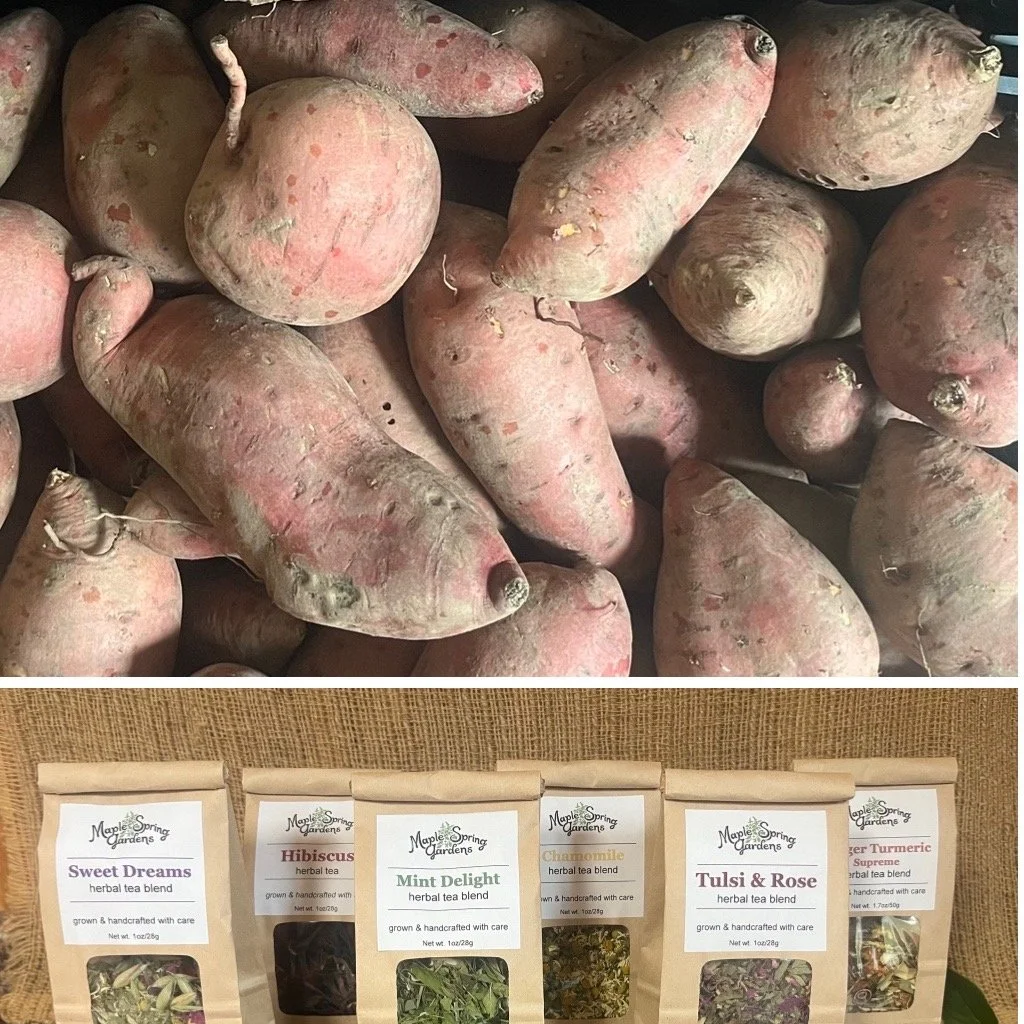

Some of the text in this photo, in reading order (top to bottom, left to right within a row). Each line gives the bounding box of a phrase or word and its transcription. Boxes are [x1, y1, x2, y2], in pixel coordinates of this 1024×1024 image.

[877, 800, 911, 823] Spring
[285, 810, 354, 832] Maple Spring
[548, 806, 618, 831] Maple Spring
[855, 816, 898, 831] Gardens
[89, 815, 170, 842] Maple Spring
[300, 823, 341, 836] Gardens
[563, 822, 605, 836] Gardens
[718, 821, 796, 849] Maple Spring
[107, 833, 154, 849] Gardens
[408, 826, 487, 853] Maple Spring
[425, 843, 473, 860] Gardens
[734, 839, 782, 855] Gardens
[849, 842, 931, 856] ger Turmeric
[281, 849, 354, 862] Hibiscus
[542, 849, 625, 862] Chamomile
[853, 859, 900, 868] Supreme
[68, 864, 192, 878] Sweet Dreams
[295, 867, 339, 875] herbal tea
[548, 866, 618, 875] herbal tea blend
[849, 870, 869, 878] erbal
[887, 869, 911, 878] blend
[396, 872, 500, 889] Mint Delight
[695, 872, 817, 888] Tulsi & Rose
[89, 883, 173, 893] herbal tea blend
[853, 887, 894, 896] handcrafted
[265, 892, 286, 900] grown
[295, 891, 336, 899] handcrafted
[338, 891, 352, 899] with
[409, 890, 489, 902] herbal tea blend
[717, 894, 796, 904] herbal tea blend
[73, 917, 97, 926] grown
[107, 916, 156, 925] handcrafted
[158, 916, 175, 924] with
[696, 924, 721, 932] grown
[731, 923, 777, 931] handcrafted
[779, 923, 795, 931] with
[389, 924, 413, 933] grown
[424, 923, 471, 932] handcrafted
[473, 923, 489, 931] with
[448, 939, 474, 947] 1oz/28g
[754, 939, 779, 947] 1oz/28g
